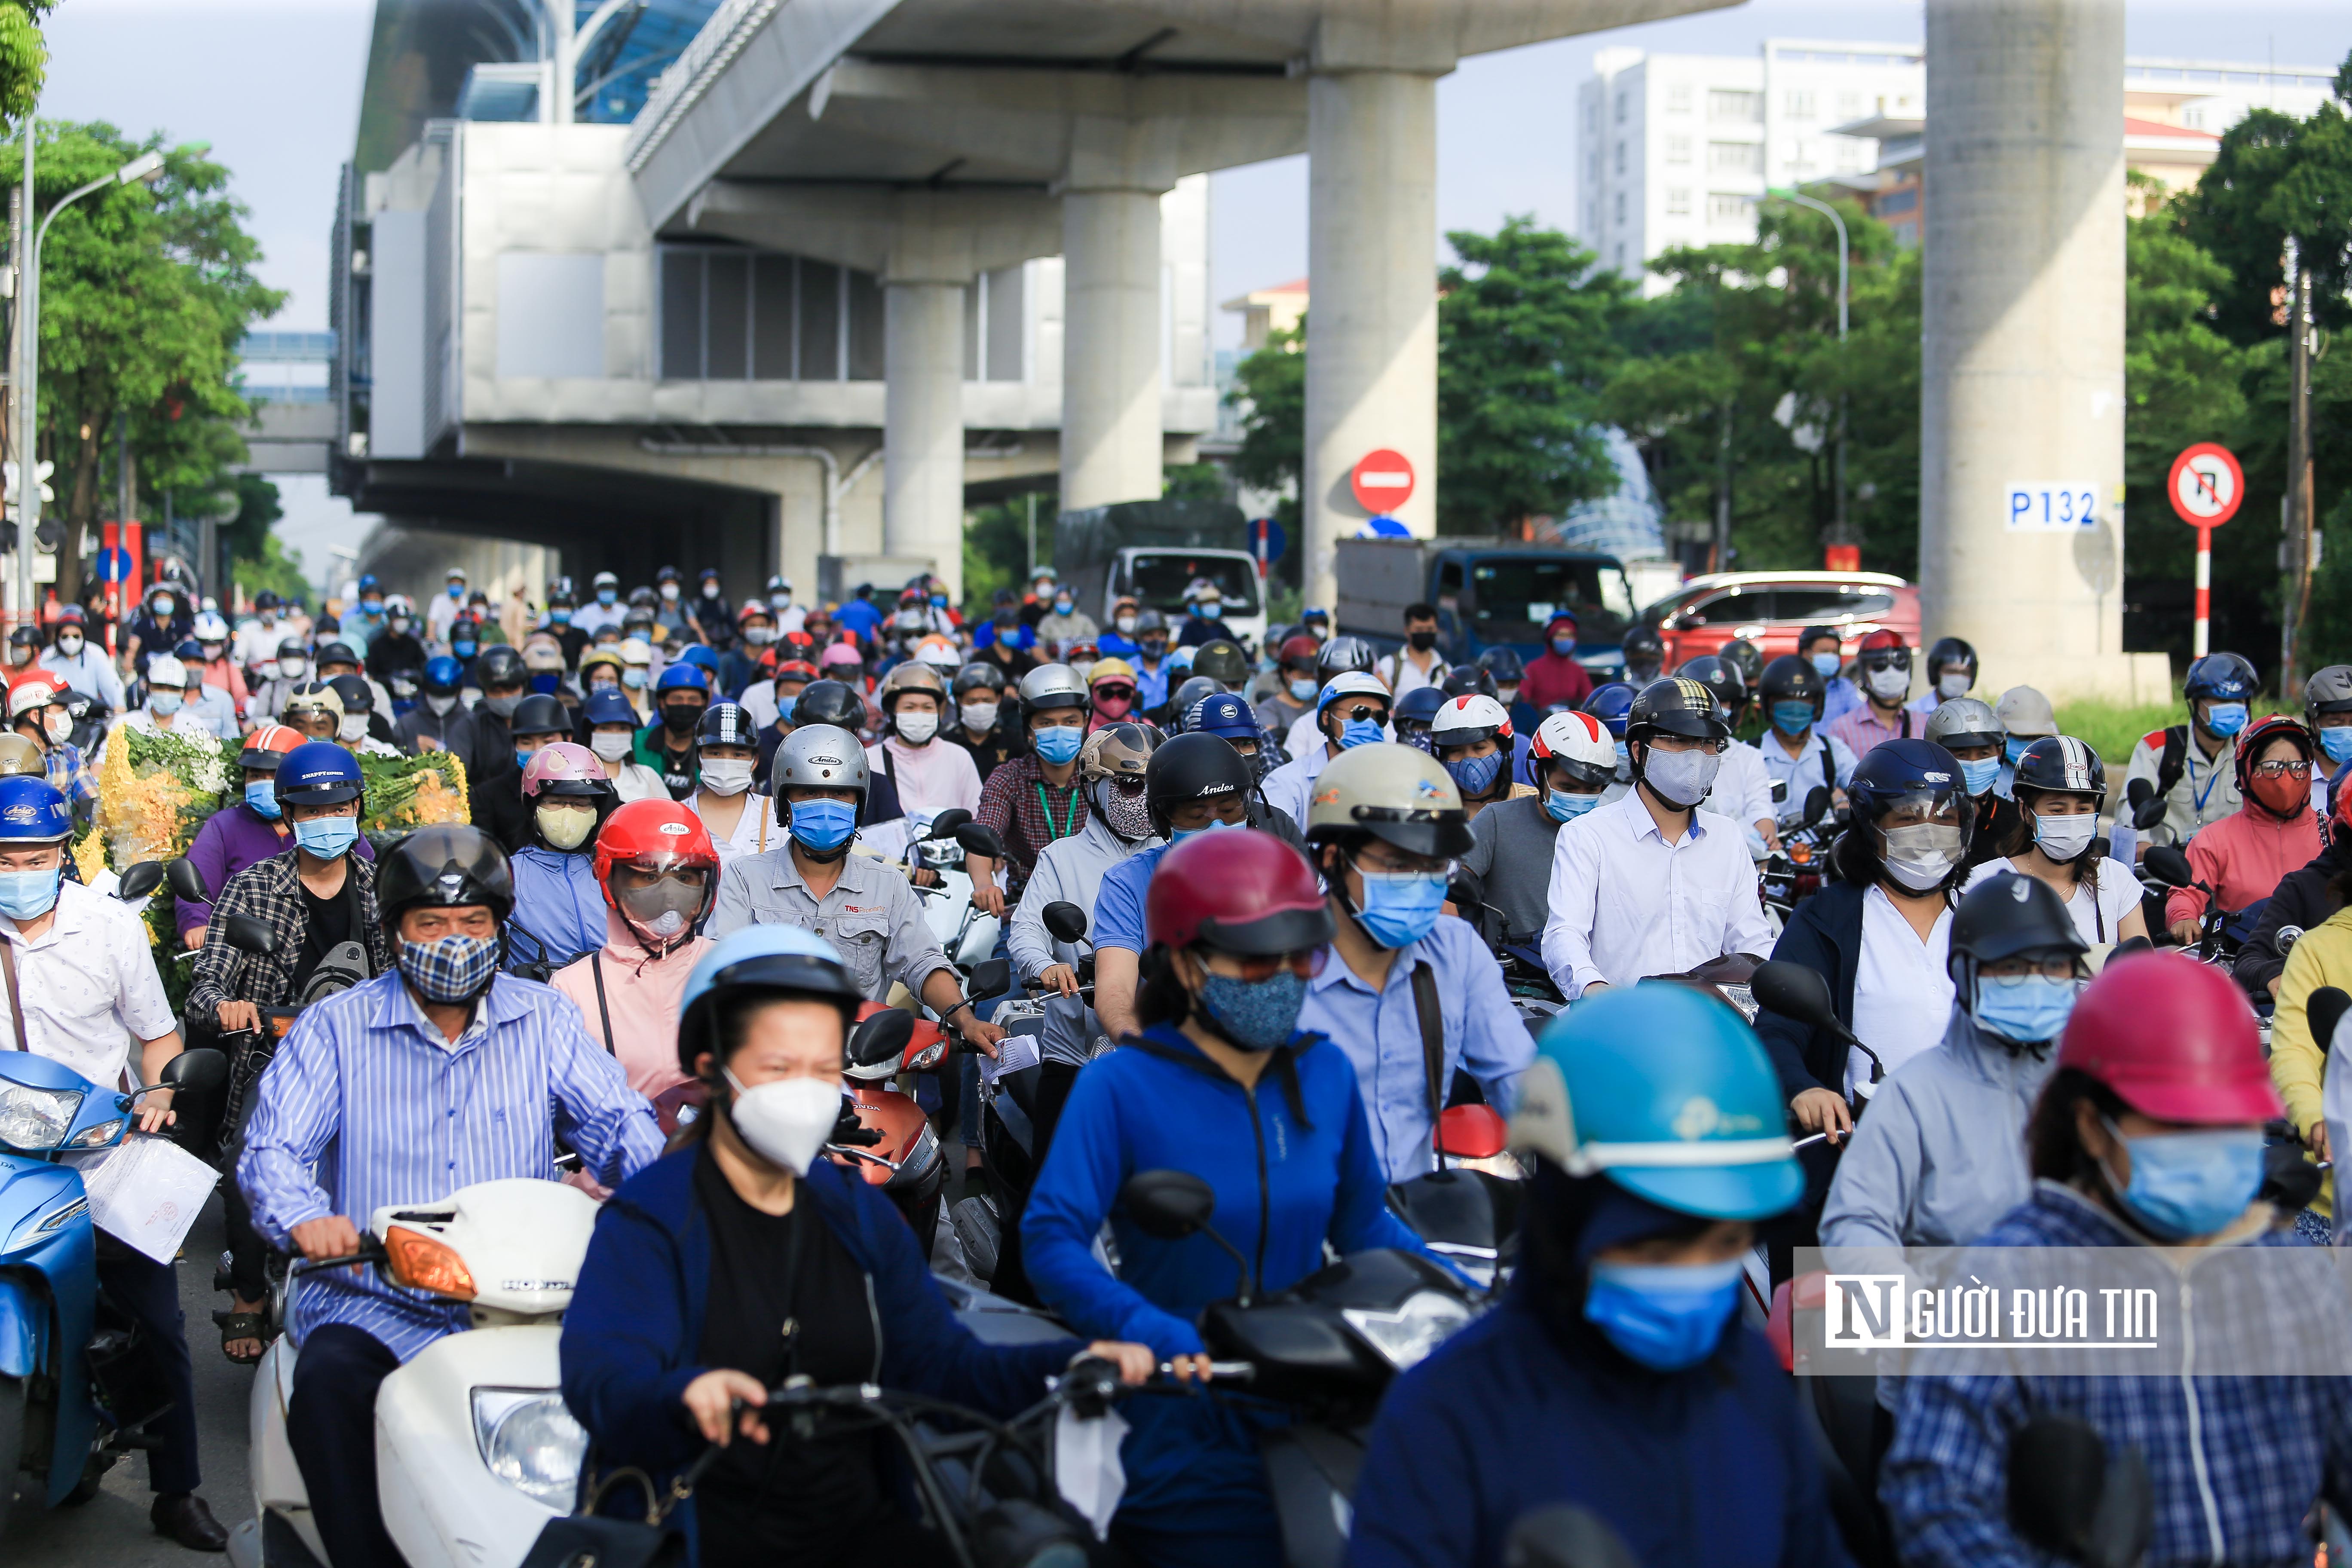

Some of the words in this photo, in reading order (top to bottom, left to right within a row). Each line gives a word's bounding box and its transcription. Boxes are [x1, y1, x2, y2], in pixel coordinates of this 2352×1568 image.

[2012, 491, 2094, 523] P132
[302, 771, 326, 780] SNAPPY
[1197, 783, 1234, 796] Andes
